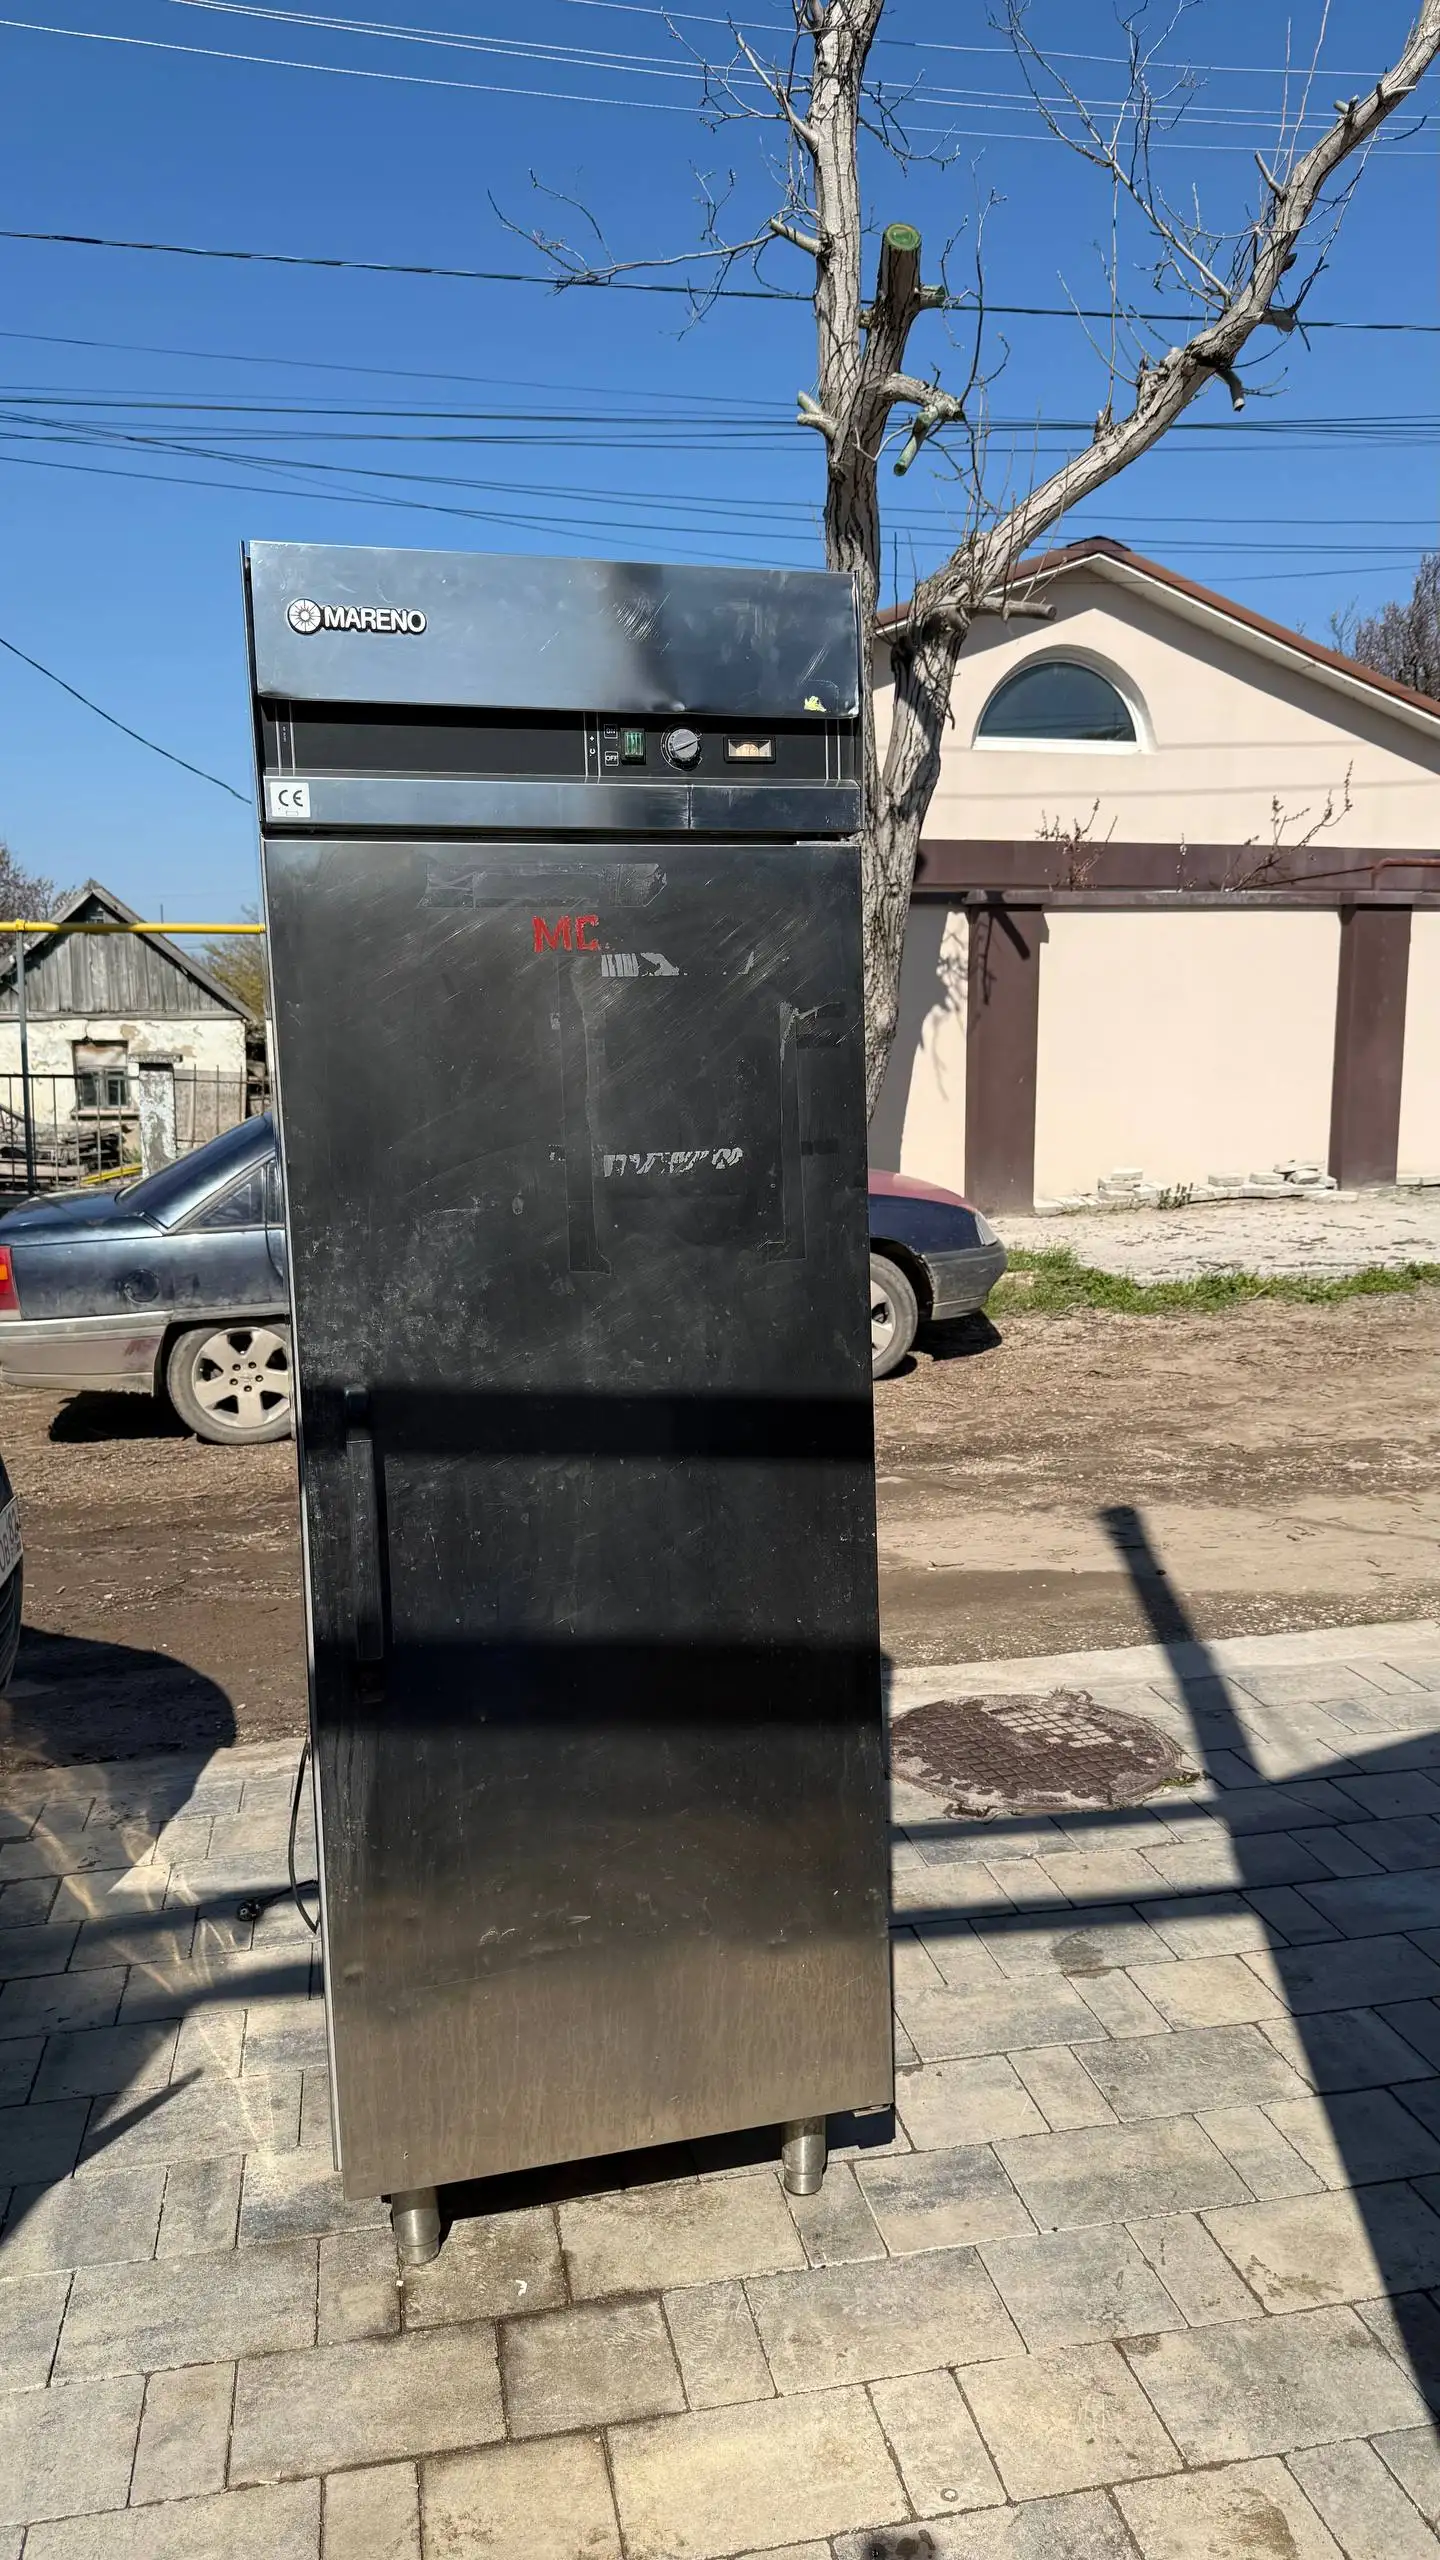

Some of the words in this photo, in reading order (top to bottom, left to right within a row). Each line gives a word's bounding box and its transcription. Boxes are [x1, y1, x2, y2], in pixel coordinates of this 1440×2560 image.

[324, 605, 427, 633] MARENO
[278, 789, 304, 807] CE
[531, 914, 600, 954] MC
